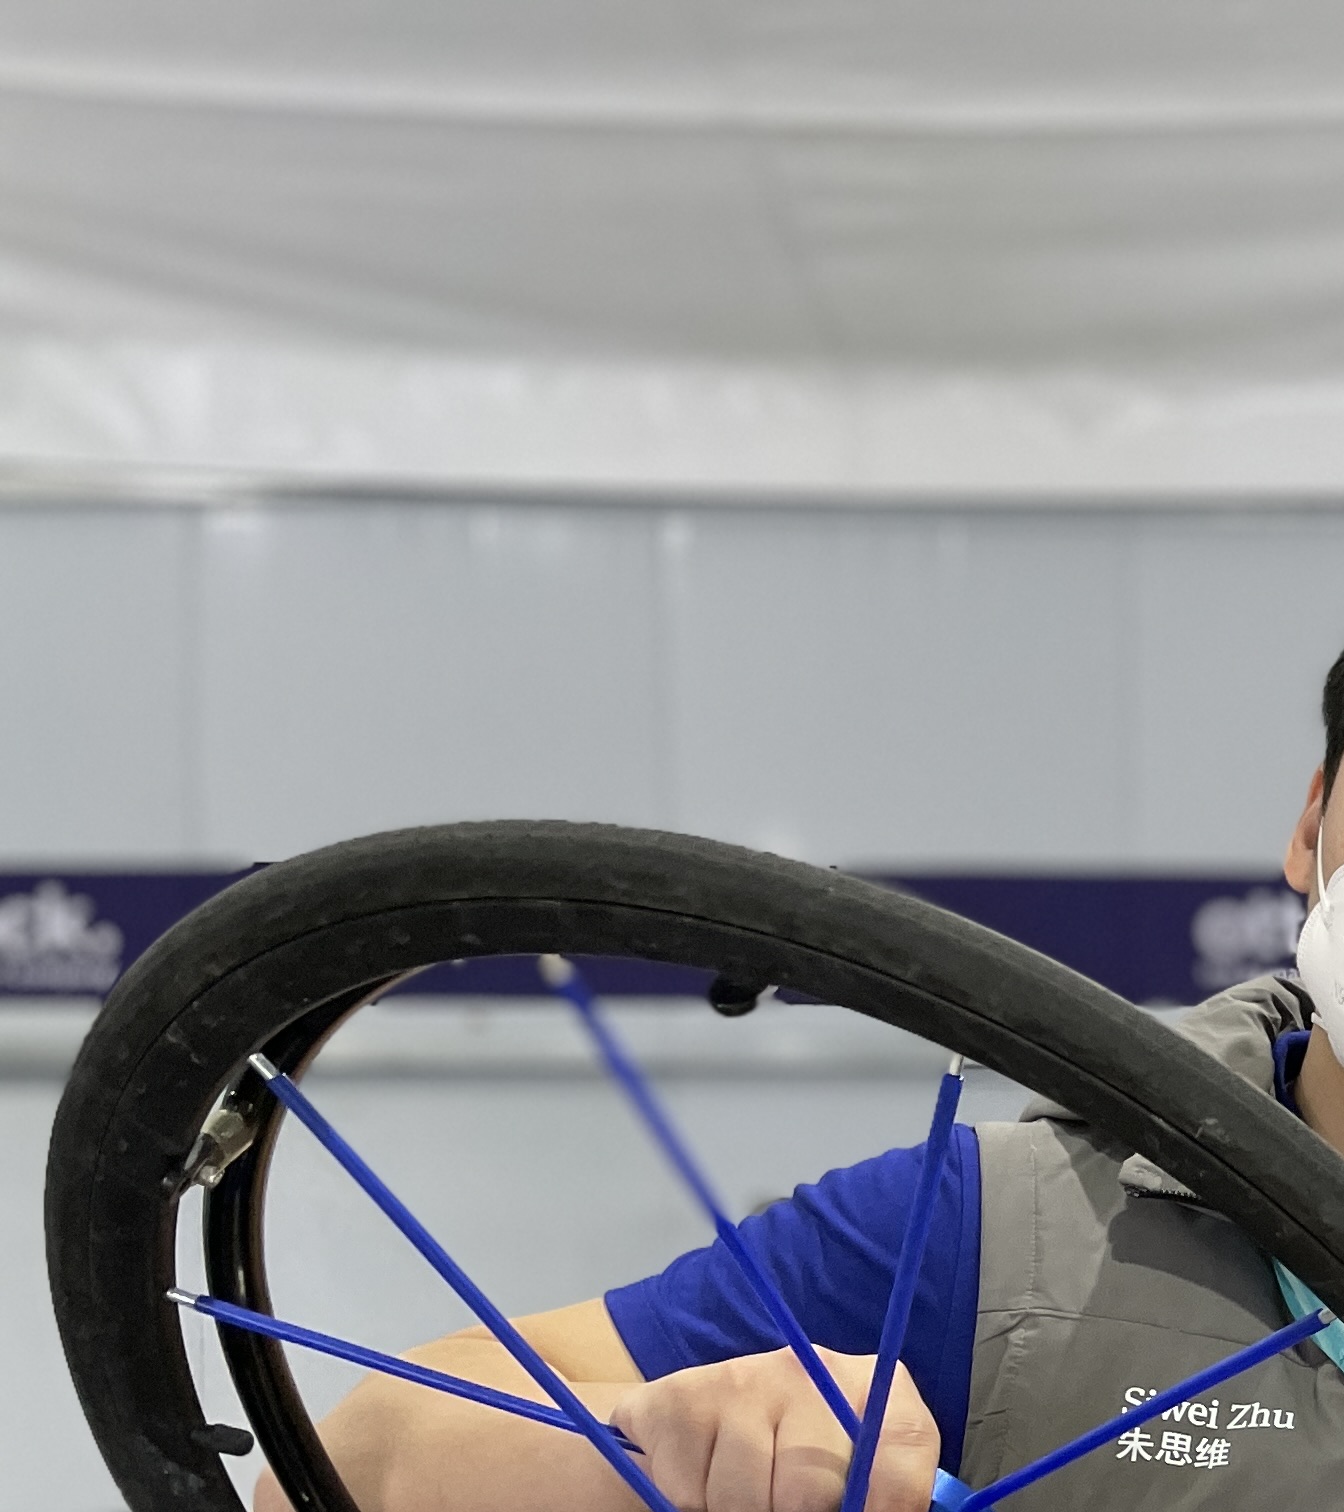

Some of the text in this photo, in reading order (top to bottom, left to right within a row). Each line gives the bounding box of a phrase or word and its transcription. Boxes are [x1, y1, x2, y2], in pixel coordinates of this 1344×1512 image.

[1226, 1401, 1295, 1430] Zhu
[1116, 1427, 1231, 1469] 朱思维
